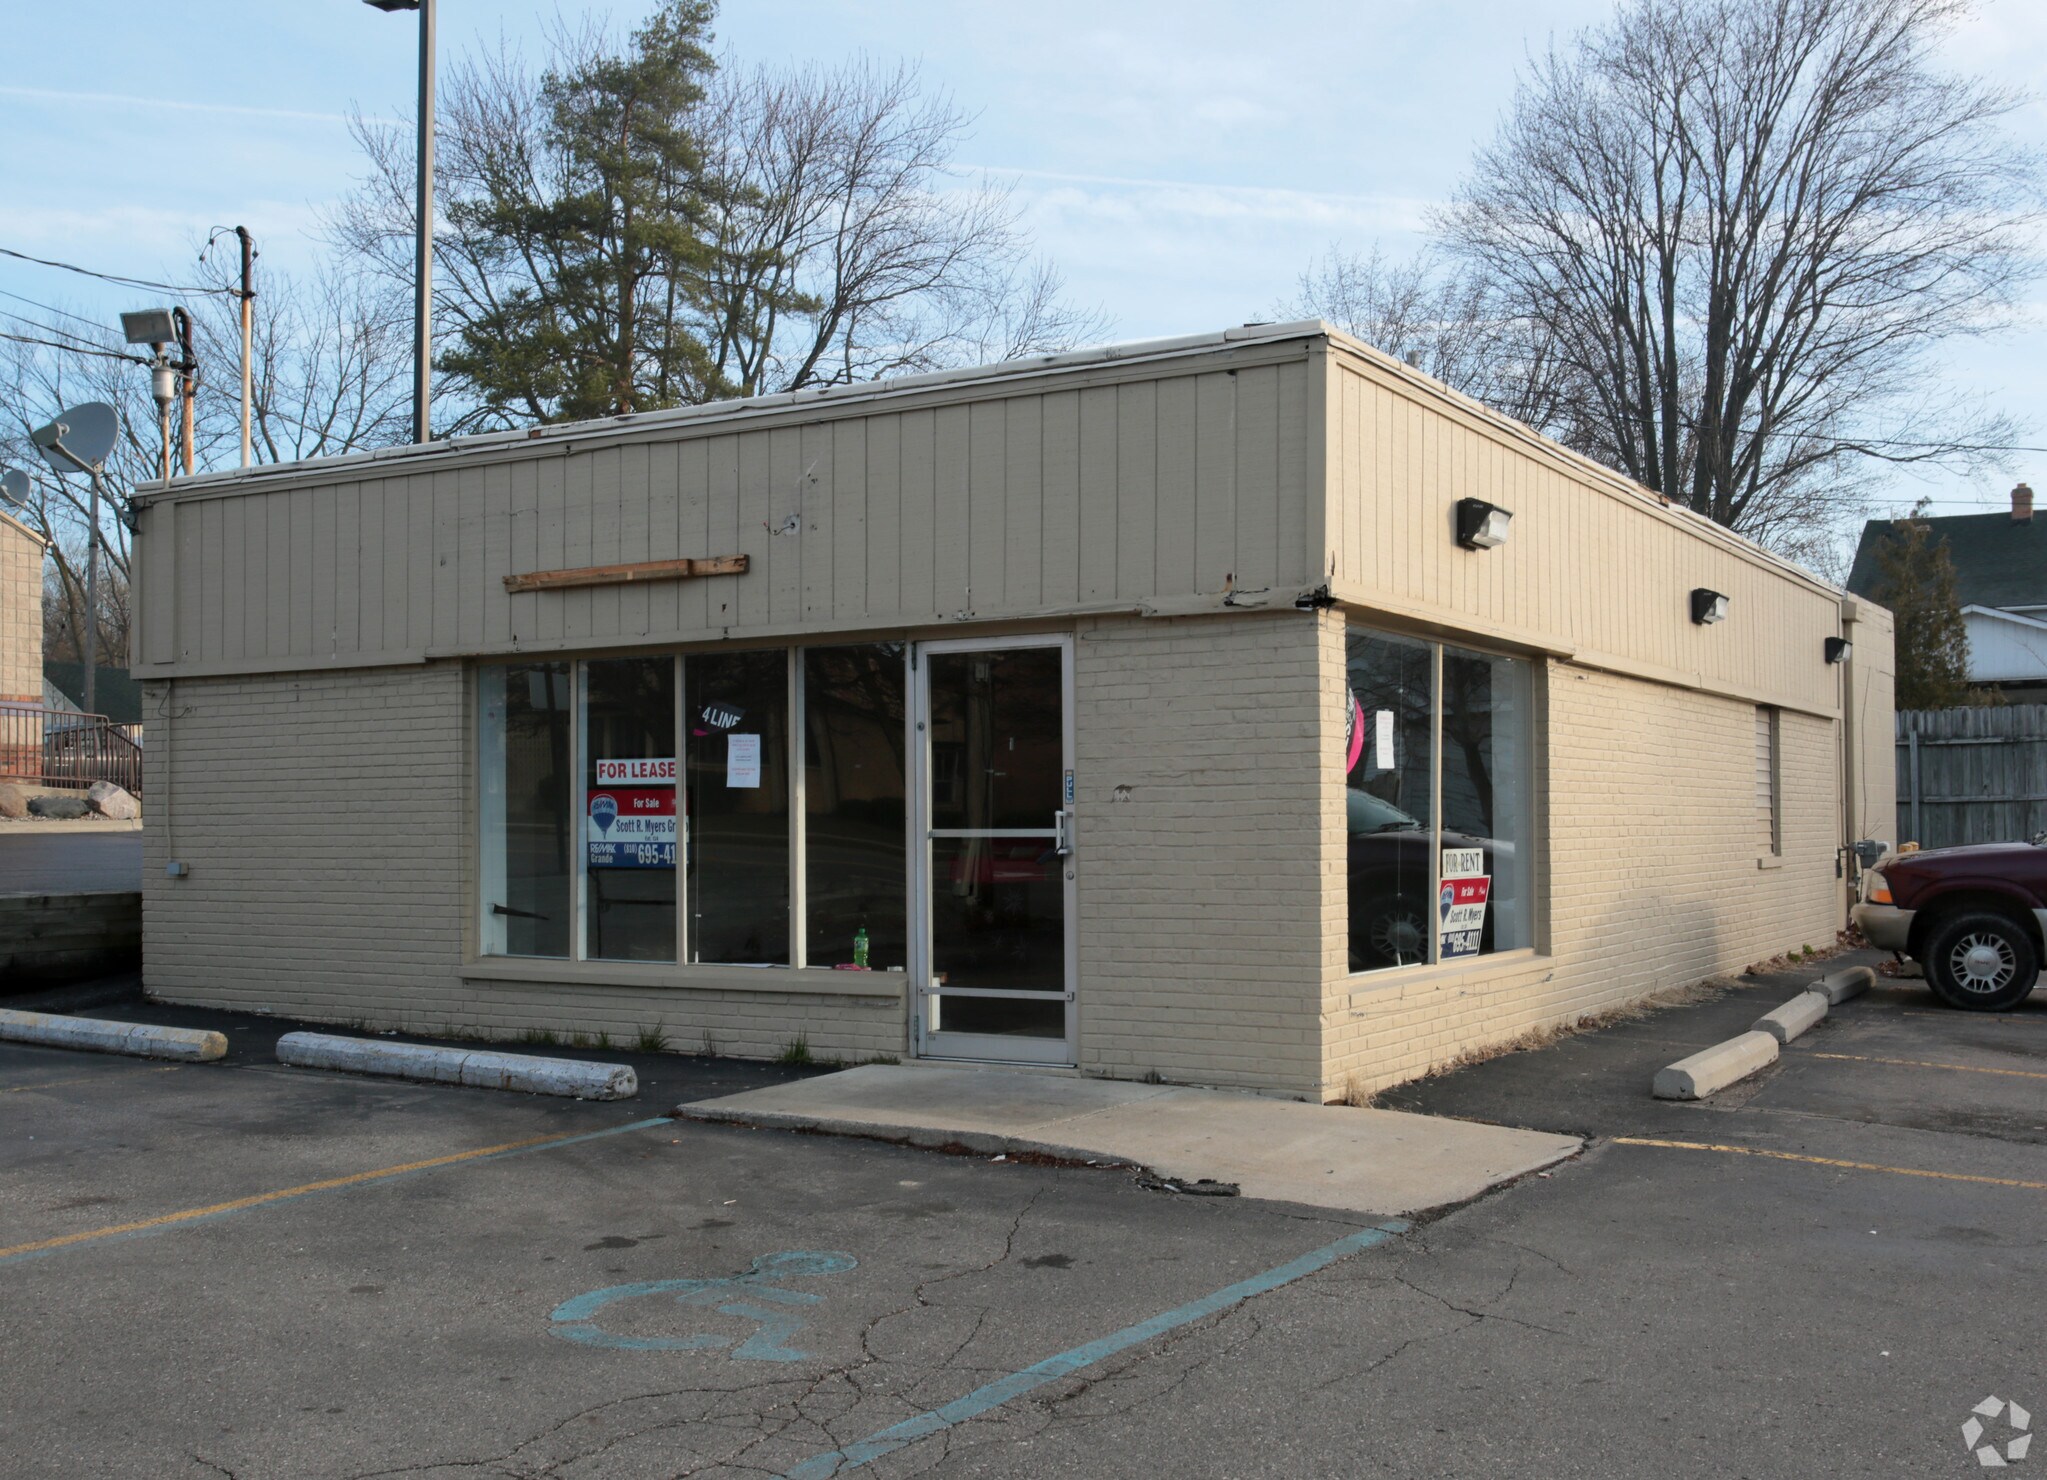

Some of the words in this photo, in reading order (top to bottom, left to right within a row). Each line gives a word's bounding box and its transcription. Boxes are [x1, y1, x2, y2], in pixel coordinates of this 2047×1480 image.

[702, 706, 711, 722] 4
[598, 762, 627, 779] FOR
[631, 761, 677, 778] LEASE
[633, 798, 644, 809] For
[645, 798, 660, 809] Sale
[616, 819, 635, 833] Scott
[636, 819, 644, 833] R.
[645, 819, 666, 835] Myers
[590, 843, 616, 854] RE/MAX
[638, 844, 688, 865] 695-41
[591, 853, 613, 864] Grande
[1445, 853, 1458, 873] FOR
[1460, 852, 1481, 873] RENT
[1450, 909, 1463, 924] Scott
[1468, 907, 1482, 924] Myers
